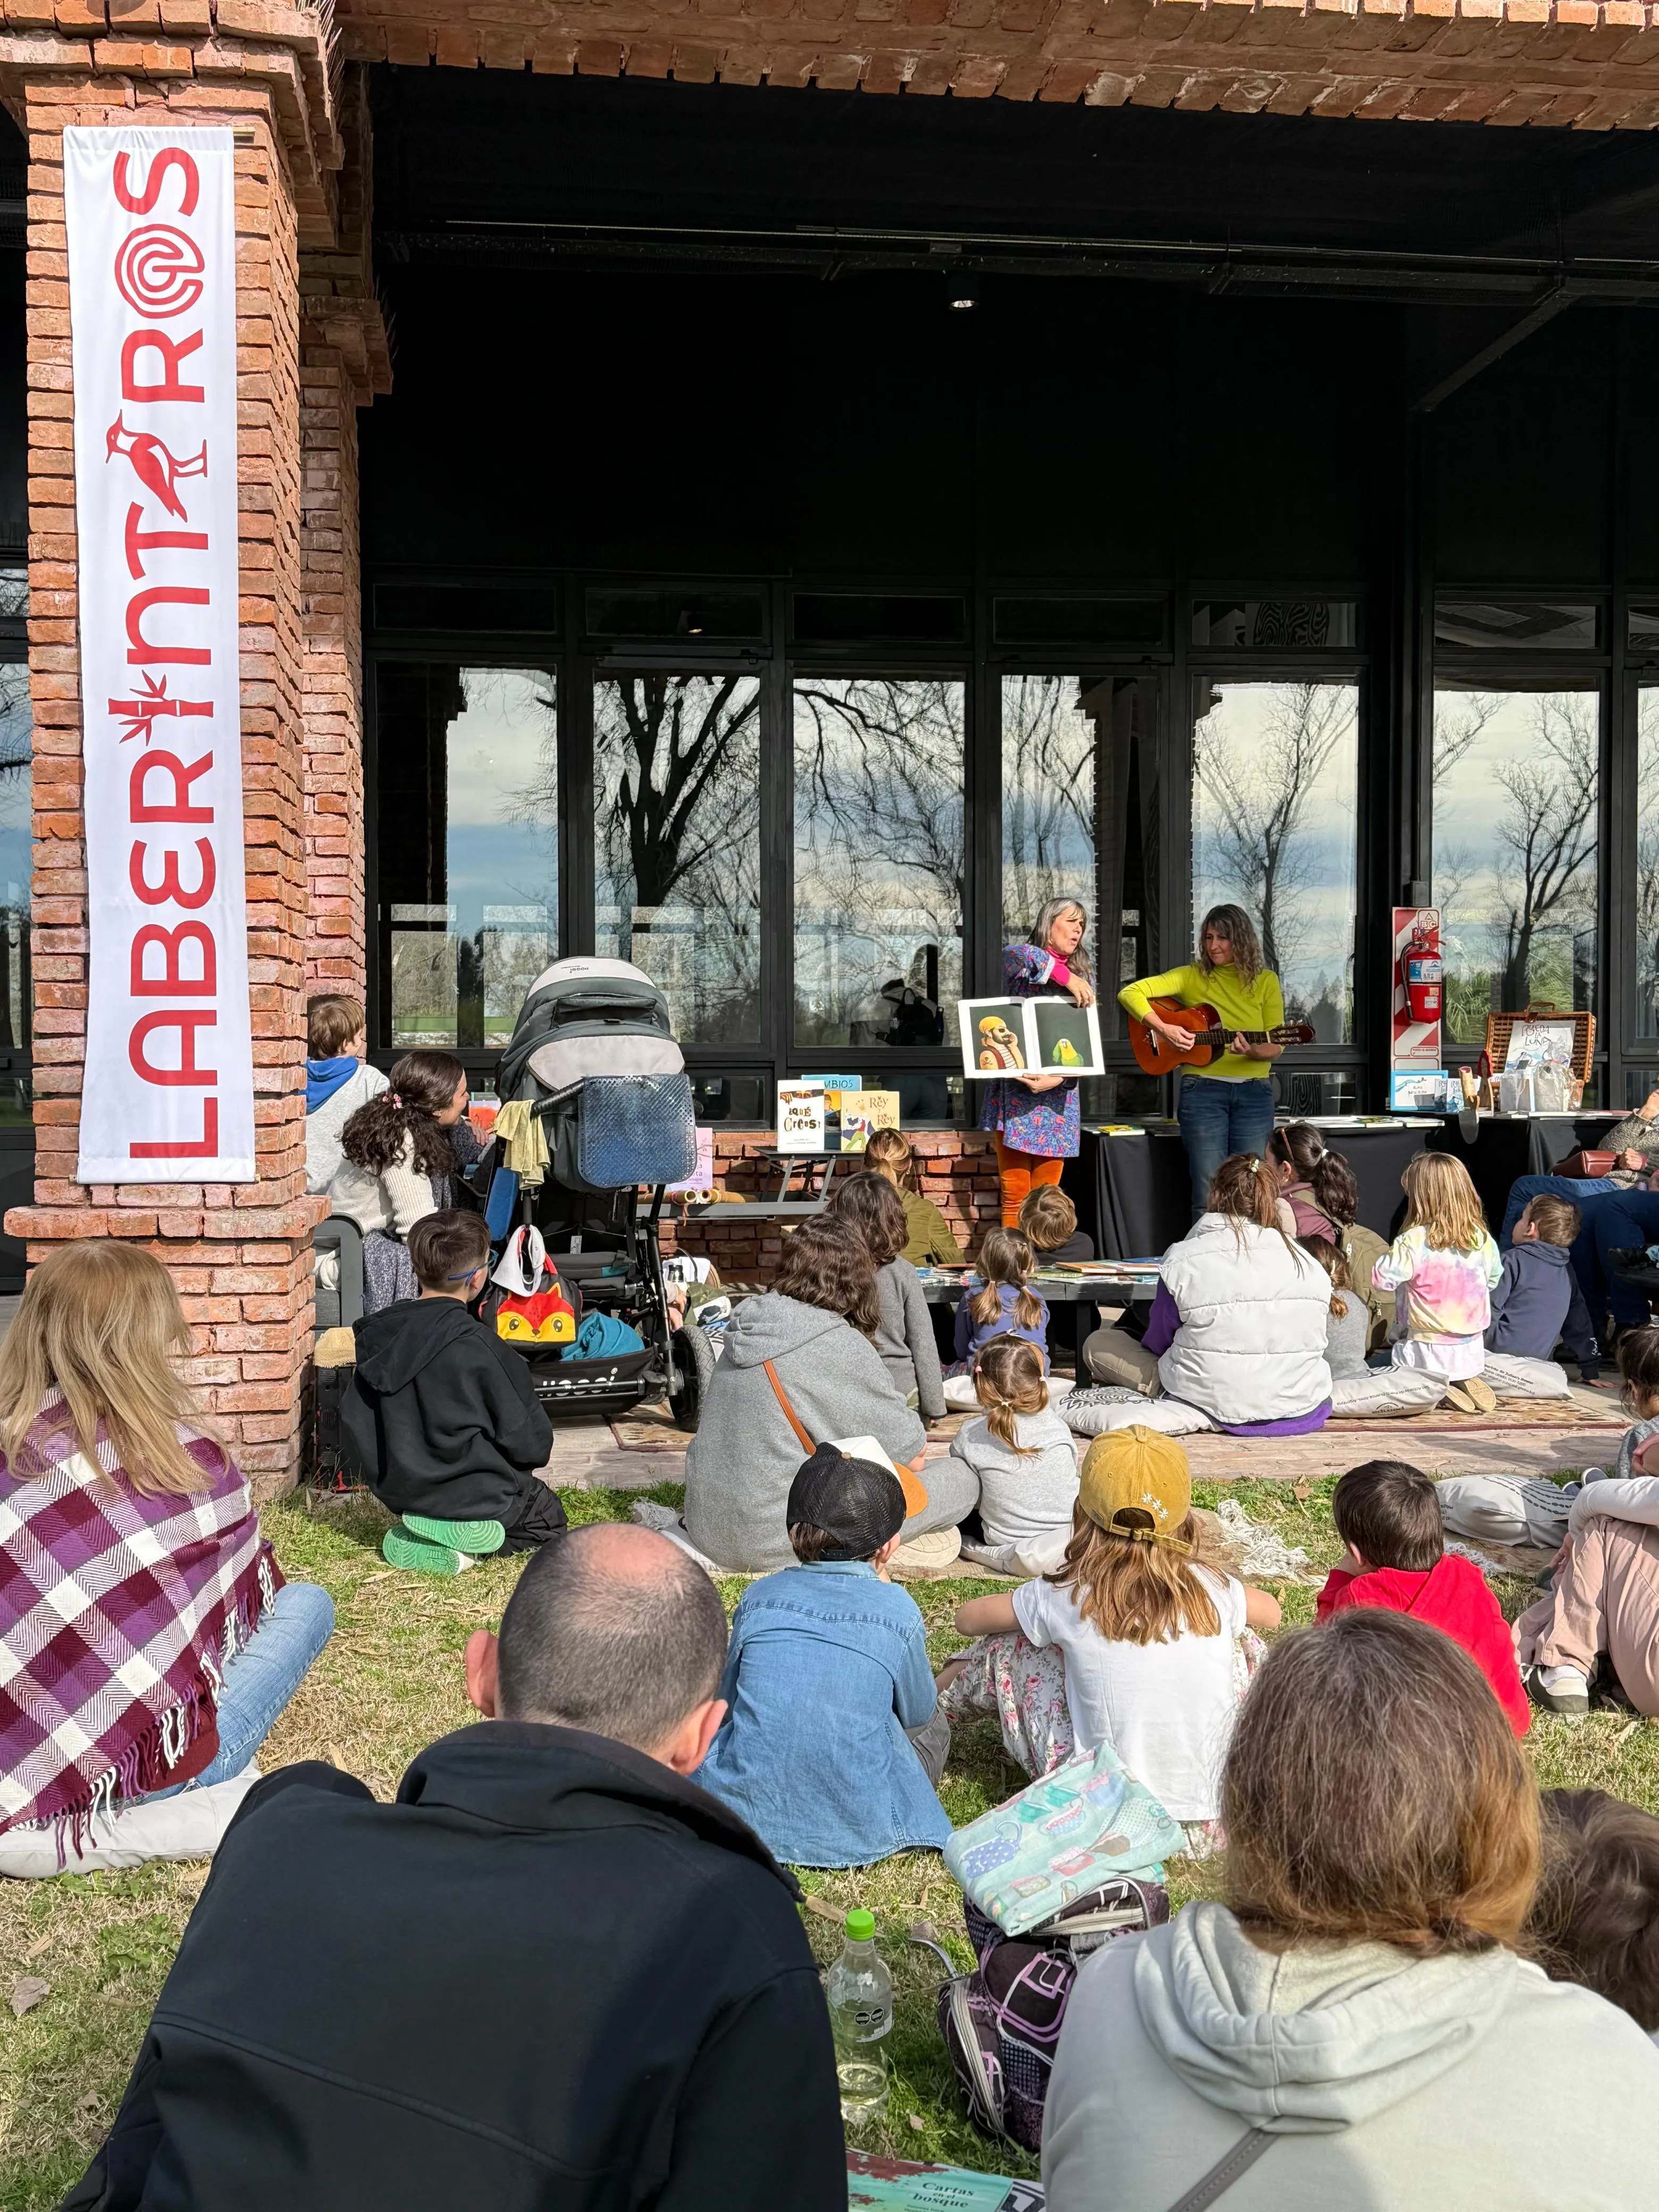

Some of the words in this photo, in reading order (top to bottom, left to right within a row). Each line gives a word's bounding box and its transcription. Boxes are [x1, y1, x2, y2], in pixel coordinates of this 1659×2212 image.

[1525, 1036, 1552, 1046] LUNA
[824, 1080, 853, 1088] MBIOS
[869, 1096, 889, 1109] Rey
[877, 1113, 895, 1127] Rey
[923, 2182, 974, 2197] Cartas
[913, 2193, 968, 2208] bosque
